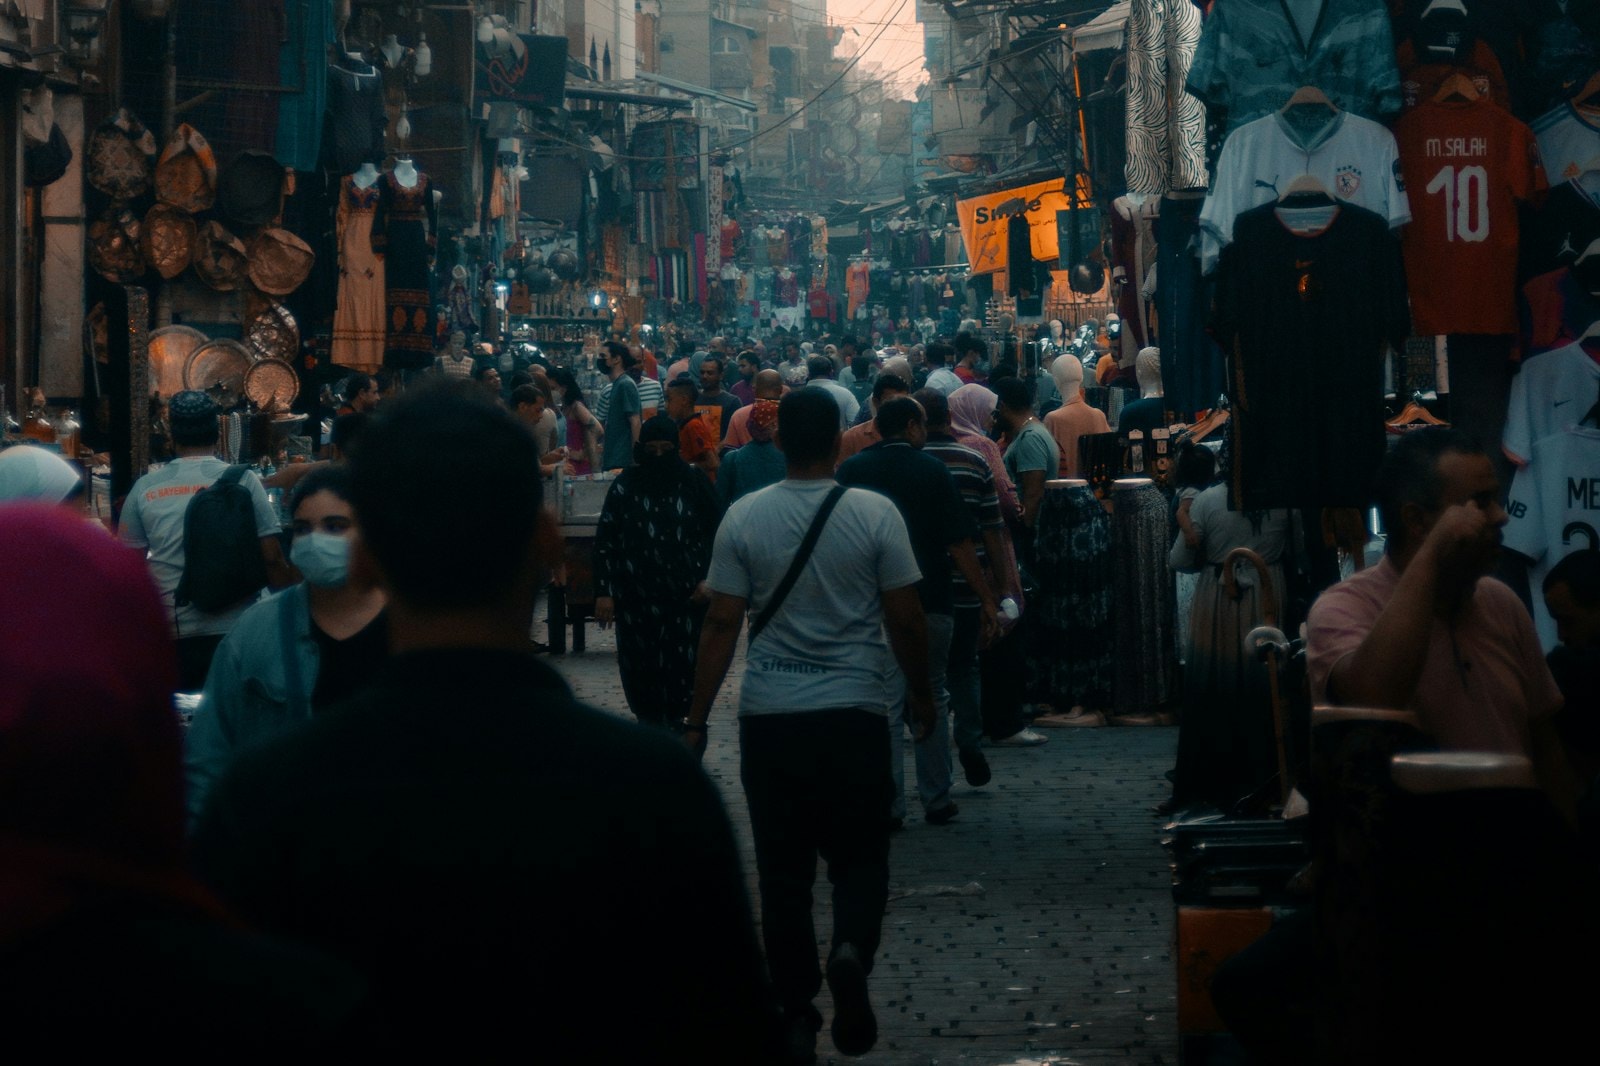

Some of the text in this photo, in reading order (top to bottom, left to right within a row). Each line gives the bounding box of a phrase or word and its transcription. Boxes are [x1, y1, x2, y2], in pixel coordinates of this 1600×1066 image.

[1426, 138, 1487, 156] M.SALAH
[1426, 165, 1489, 242] 10
[1567, 477, 1600, 510] ME
